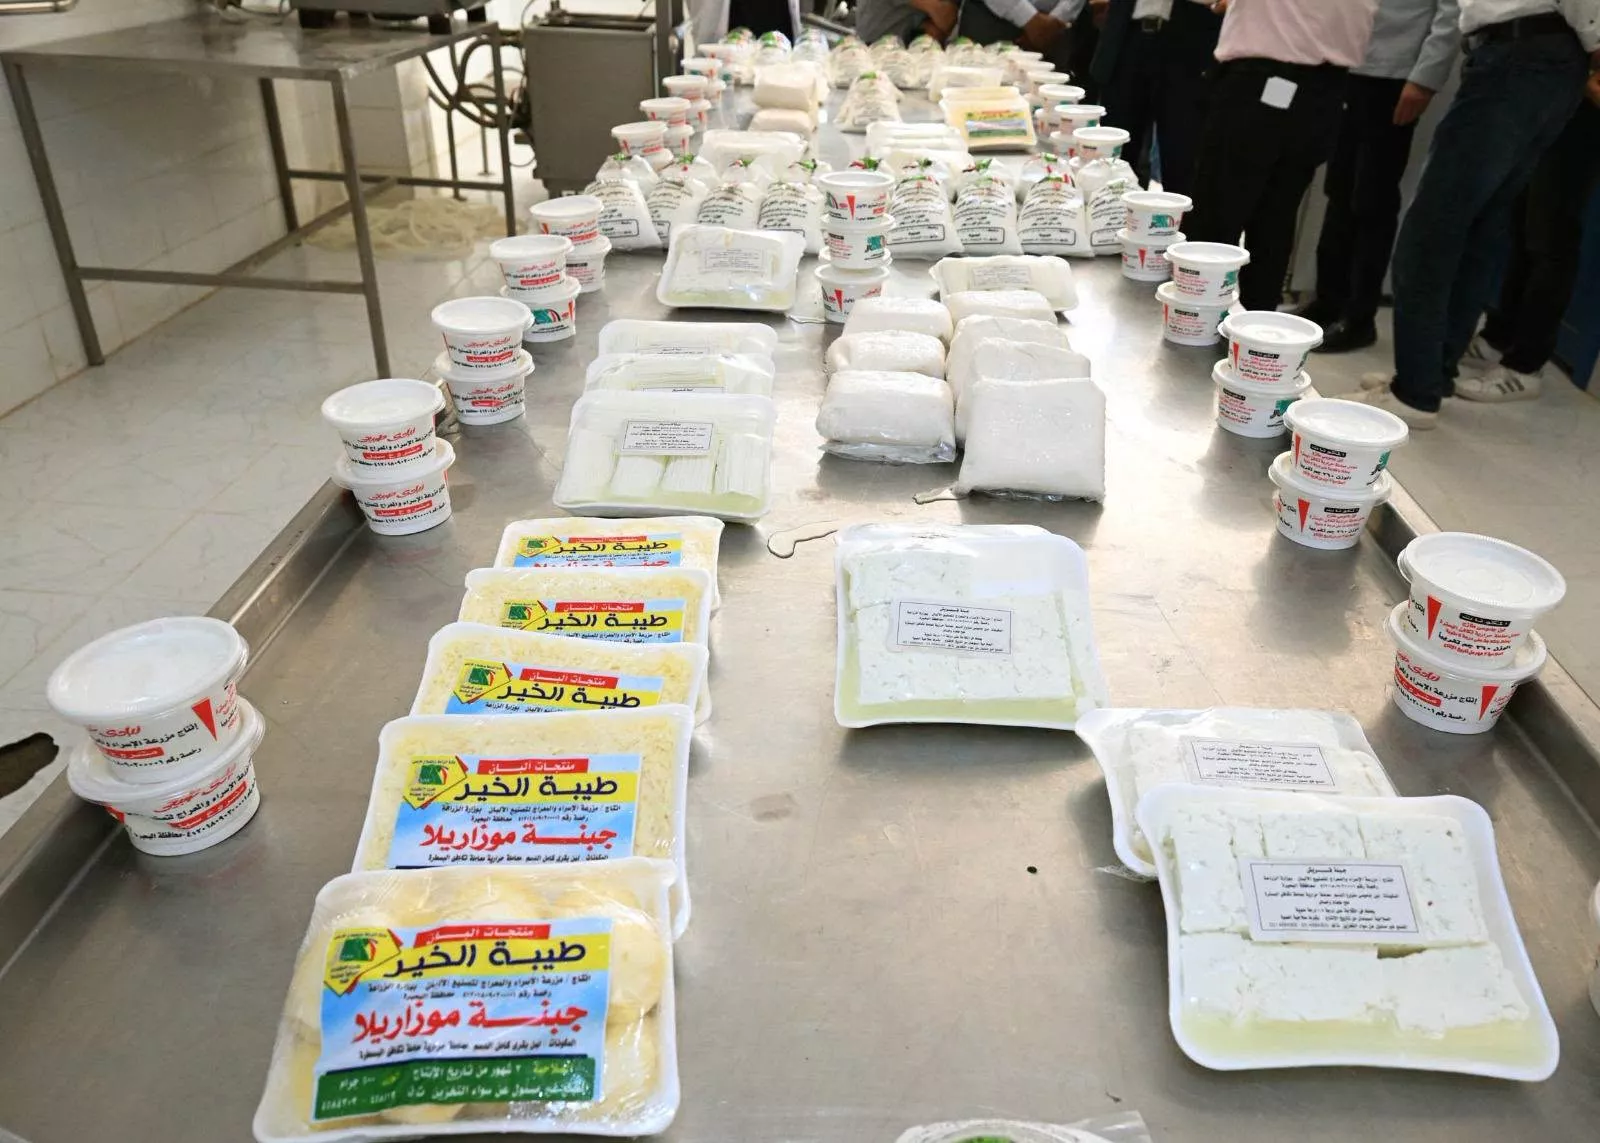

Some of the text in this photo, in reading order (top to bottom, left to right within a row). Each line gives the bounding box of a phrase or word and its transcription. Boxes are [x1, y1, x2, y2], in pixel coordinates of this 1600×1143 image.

[554, 540, 669, 554] طيبة الخير
[537, 614, 668, 630] طيبة الخير
[497, 683, 641, 710] طيبة الخير
[1434, 688, 1458, 700] مزرعة
[1459, 696, 1478, 704] إنتاج
[177, 722, 199, 738] إنتاج
[144, 733, 175, 745] مزرعة
[535, 762, 575, 773] منتجات
[454, 776, 529, 802] الخير
[540, 775, 618, 801] طيبة
[419, 823, 618, 851] جبنة موزاريلا
[483, 928, 535, 940] منتجات
[383, 944, 477, 978] الخير
[488, 941, 587, 971] طيبة
[352, 999, 588, 1045] جبنة موزاريلا
